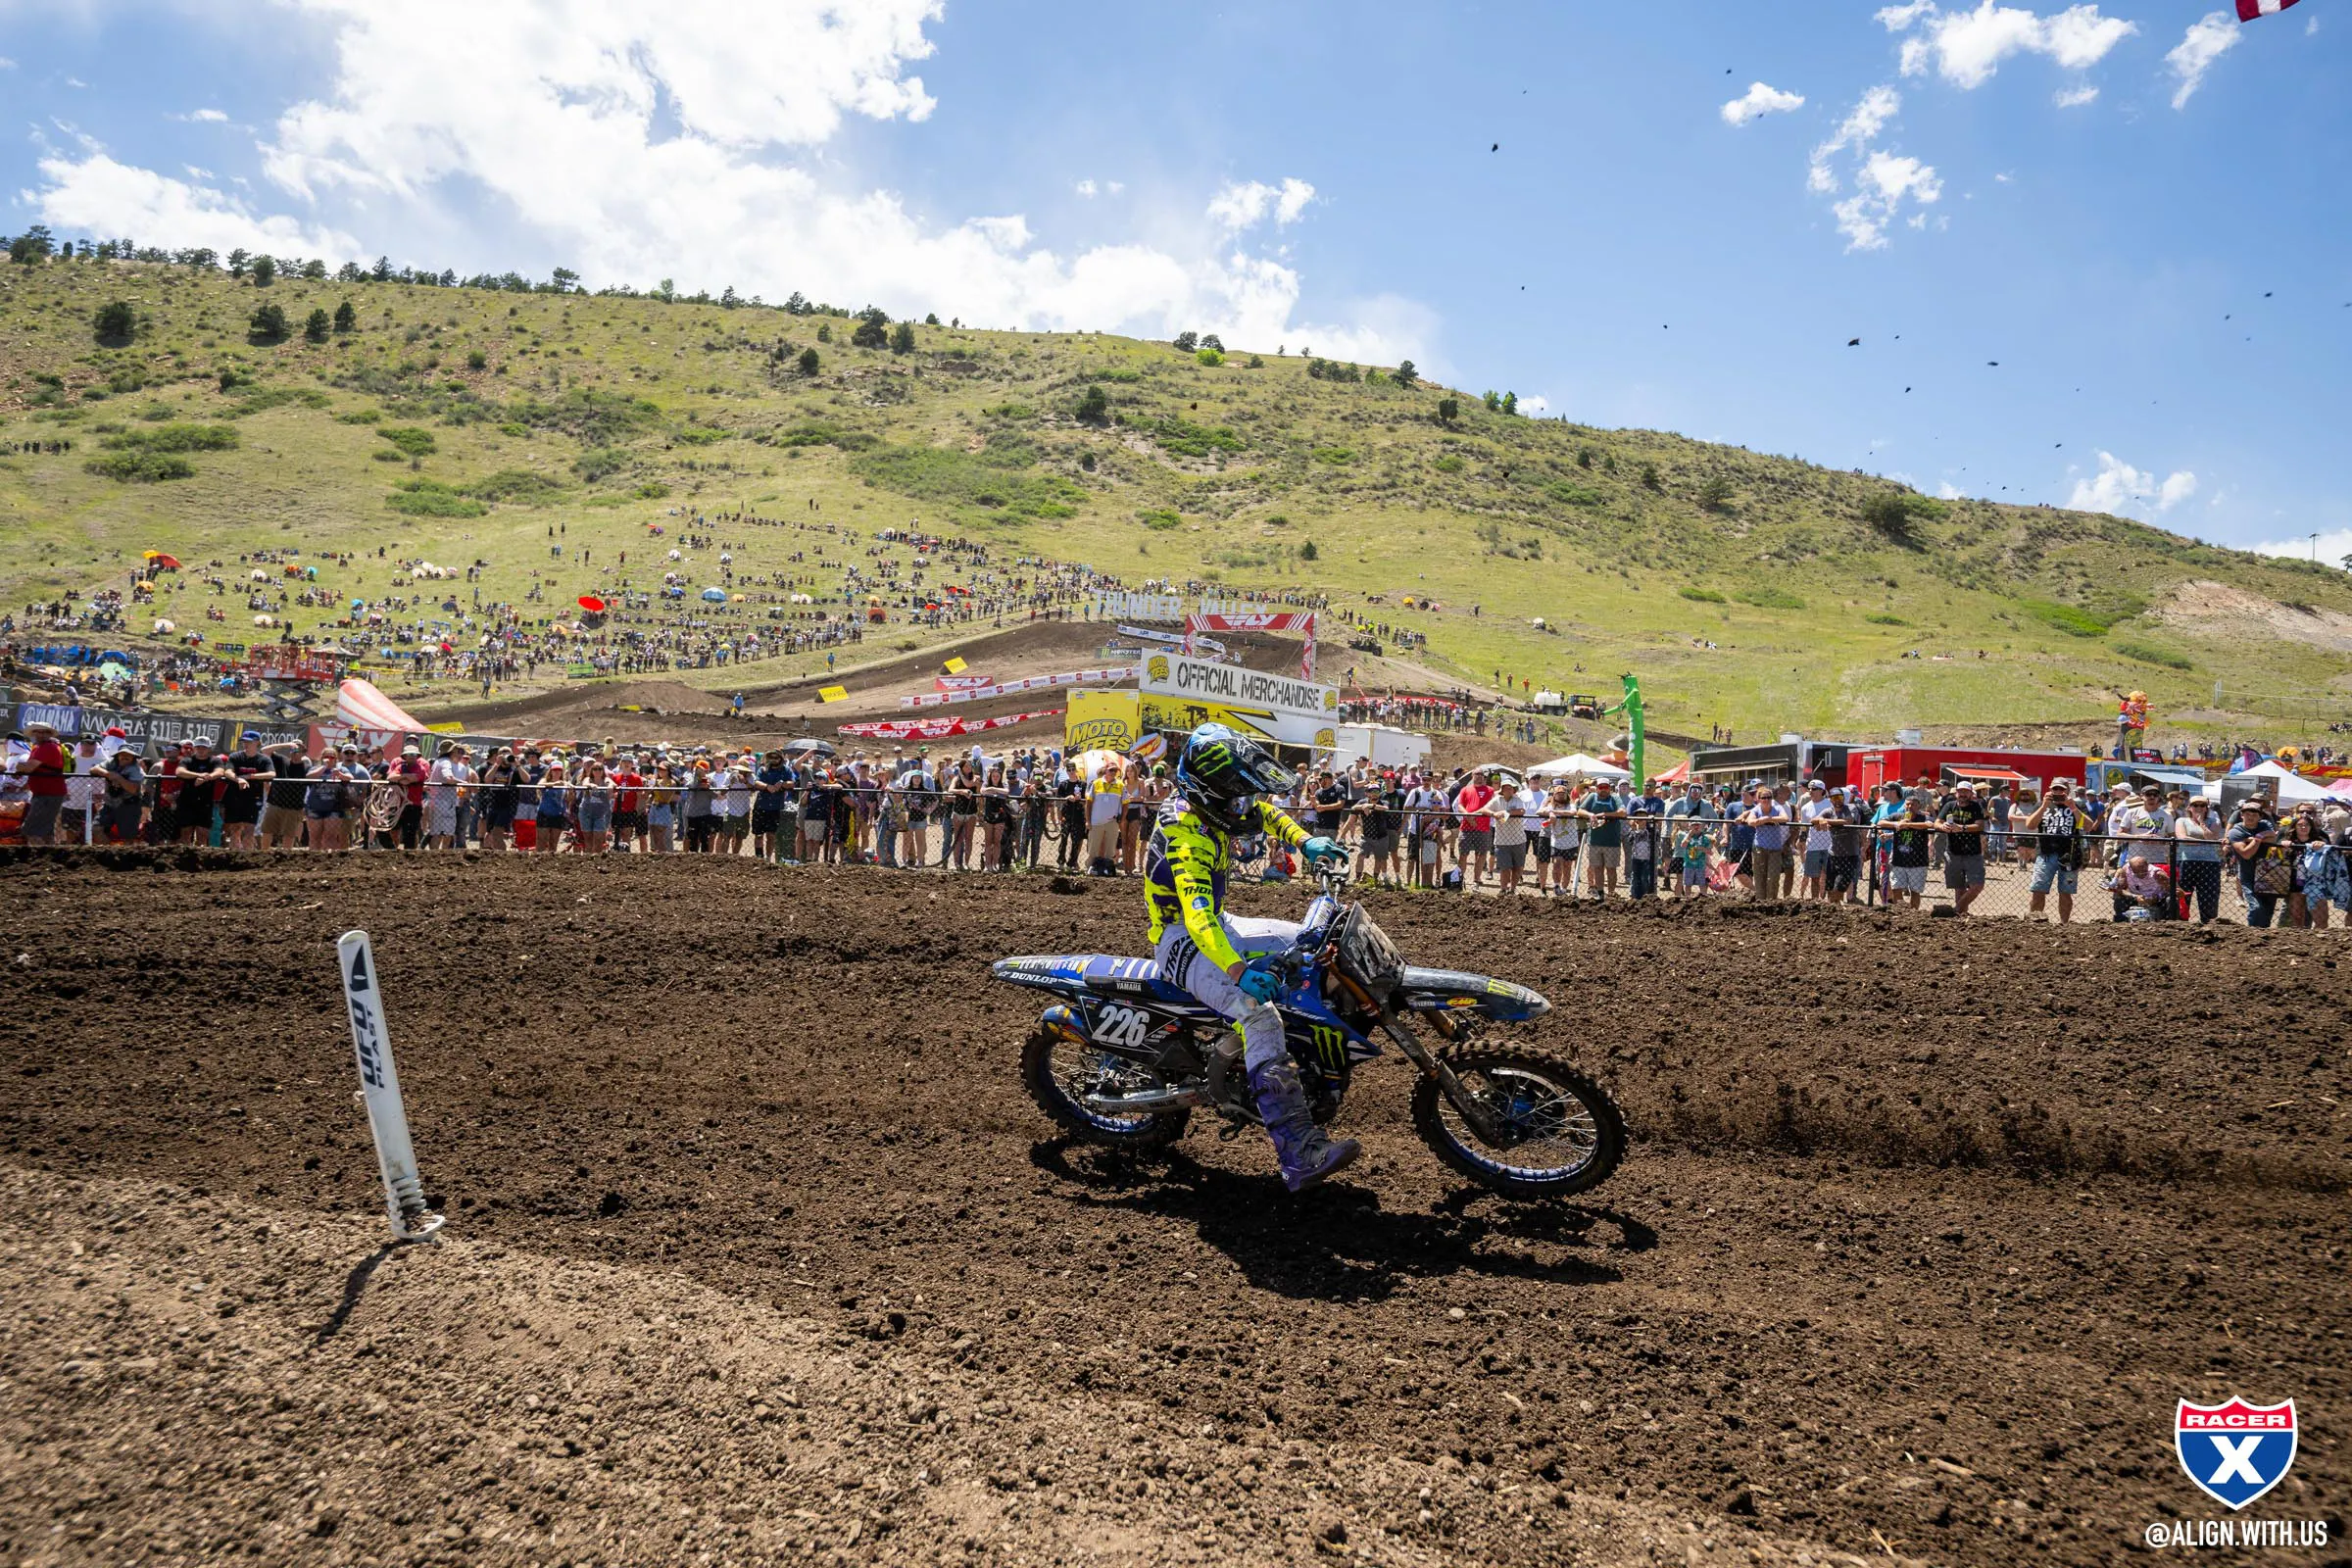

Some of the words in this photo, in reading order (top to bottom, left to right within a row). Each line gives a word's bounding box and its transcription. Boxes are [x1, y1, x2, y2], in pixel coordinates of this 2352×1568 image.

[1090, 588, 1182, 617] THUNDER
[1221, 614, 1278, 625] FLY
[1149, 656, 1168, 667] MOTO
[1151, 665, 1169, 677] TEES
[1177, 662, 1237, 697] OFFICIAL
[1242, 674, 1320, 710] MERCHANDISE
[1071, 720, 1127, 747] MOTO
[1080, 735, 1133, 754] TEES
[2041, 815, 2074, 826] BIKE
[1010, 971, 1058, 984] DUNLOP
[1116, 981, 1142, 993] YAMAHA
[1092, 1004, 1151, 1048] 226
[350, 998, 377, 1087] UFO
[365, 1004, 385, 1089] PLAST
